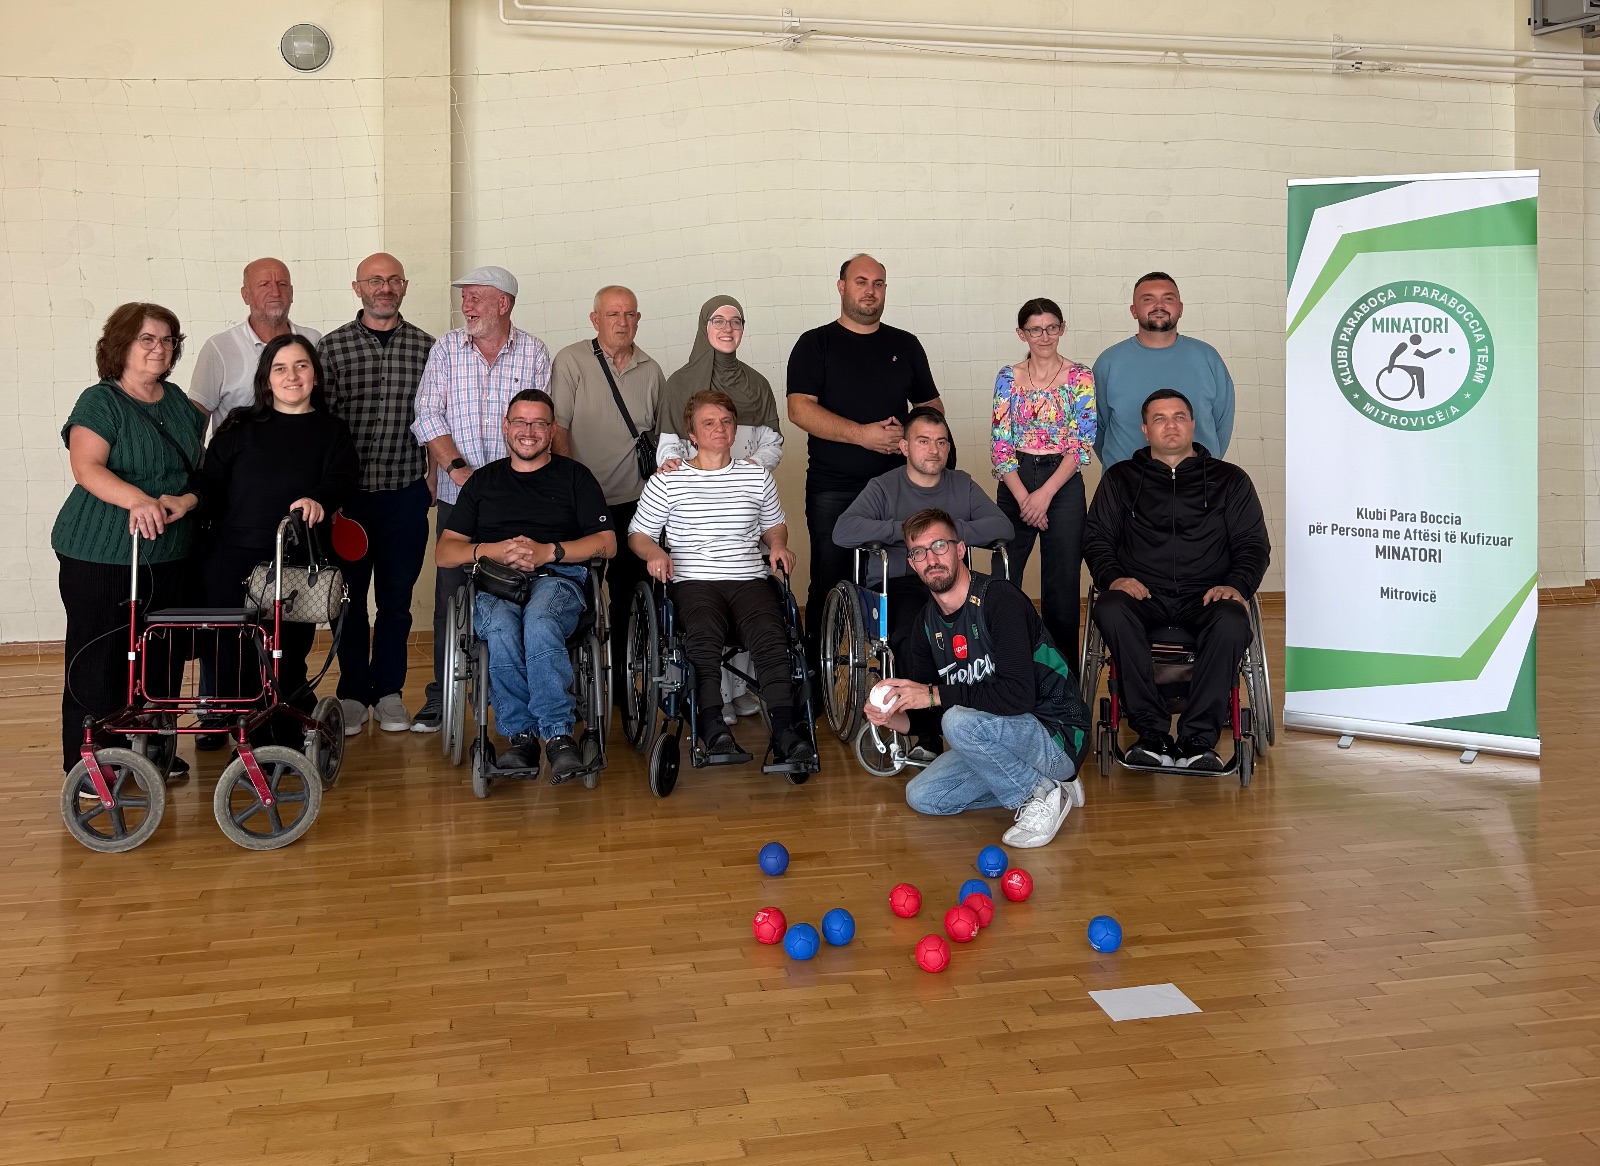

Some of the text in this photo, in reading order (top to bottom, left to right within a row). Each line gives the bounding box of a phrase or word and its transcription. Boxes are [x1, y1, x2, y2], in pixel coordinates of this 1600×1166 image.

[1339, 289, 1397, 343] PARABOÇA
[1372, 317, 1449, 334] MINATORI
[1412, 286, 1485, 343] PARABOCCIA
[1337, 345, 1354, 386] KLUBI
[1472, 346, 1489, 384] TEAM
[1356, 507, 1462, 526] Klubi Para Boccia
[1308, 522, 1514, 547] për Persona me Aftësi të Kufizuar
[1375, 545, 1442, 563] MINATORI
[1380, 586, 1437, 603] Mitrovicë
